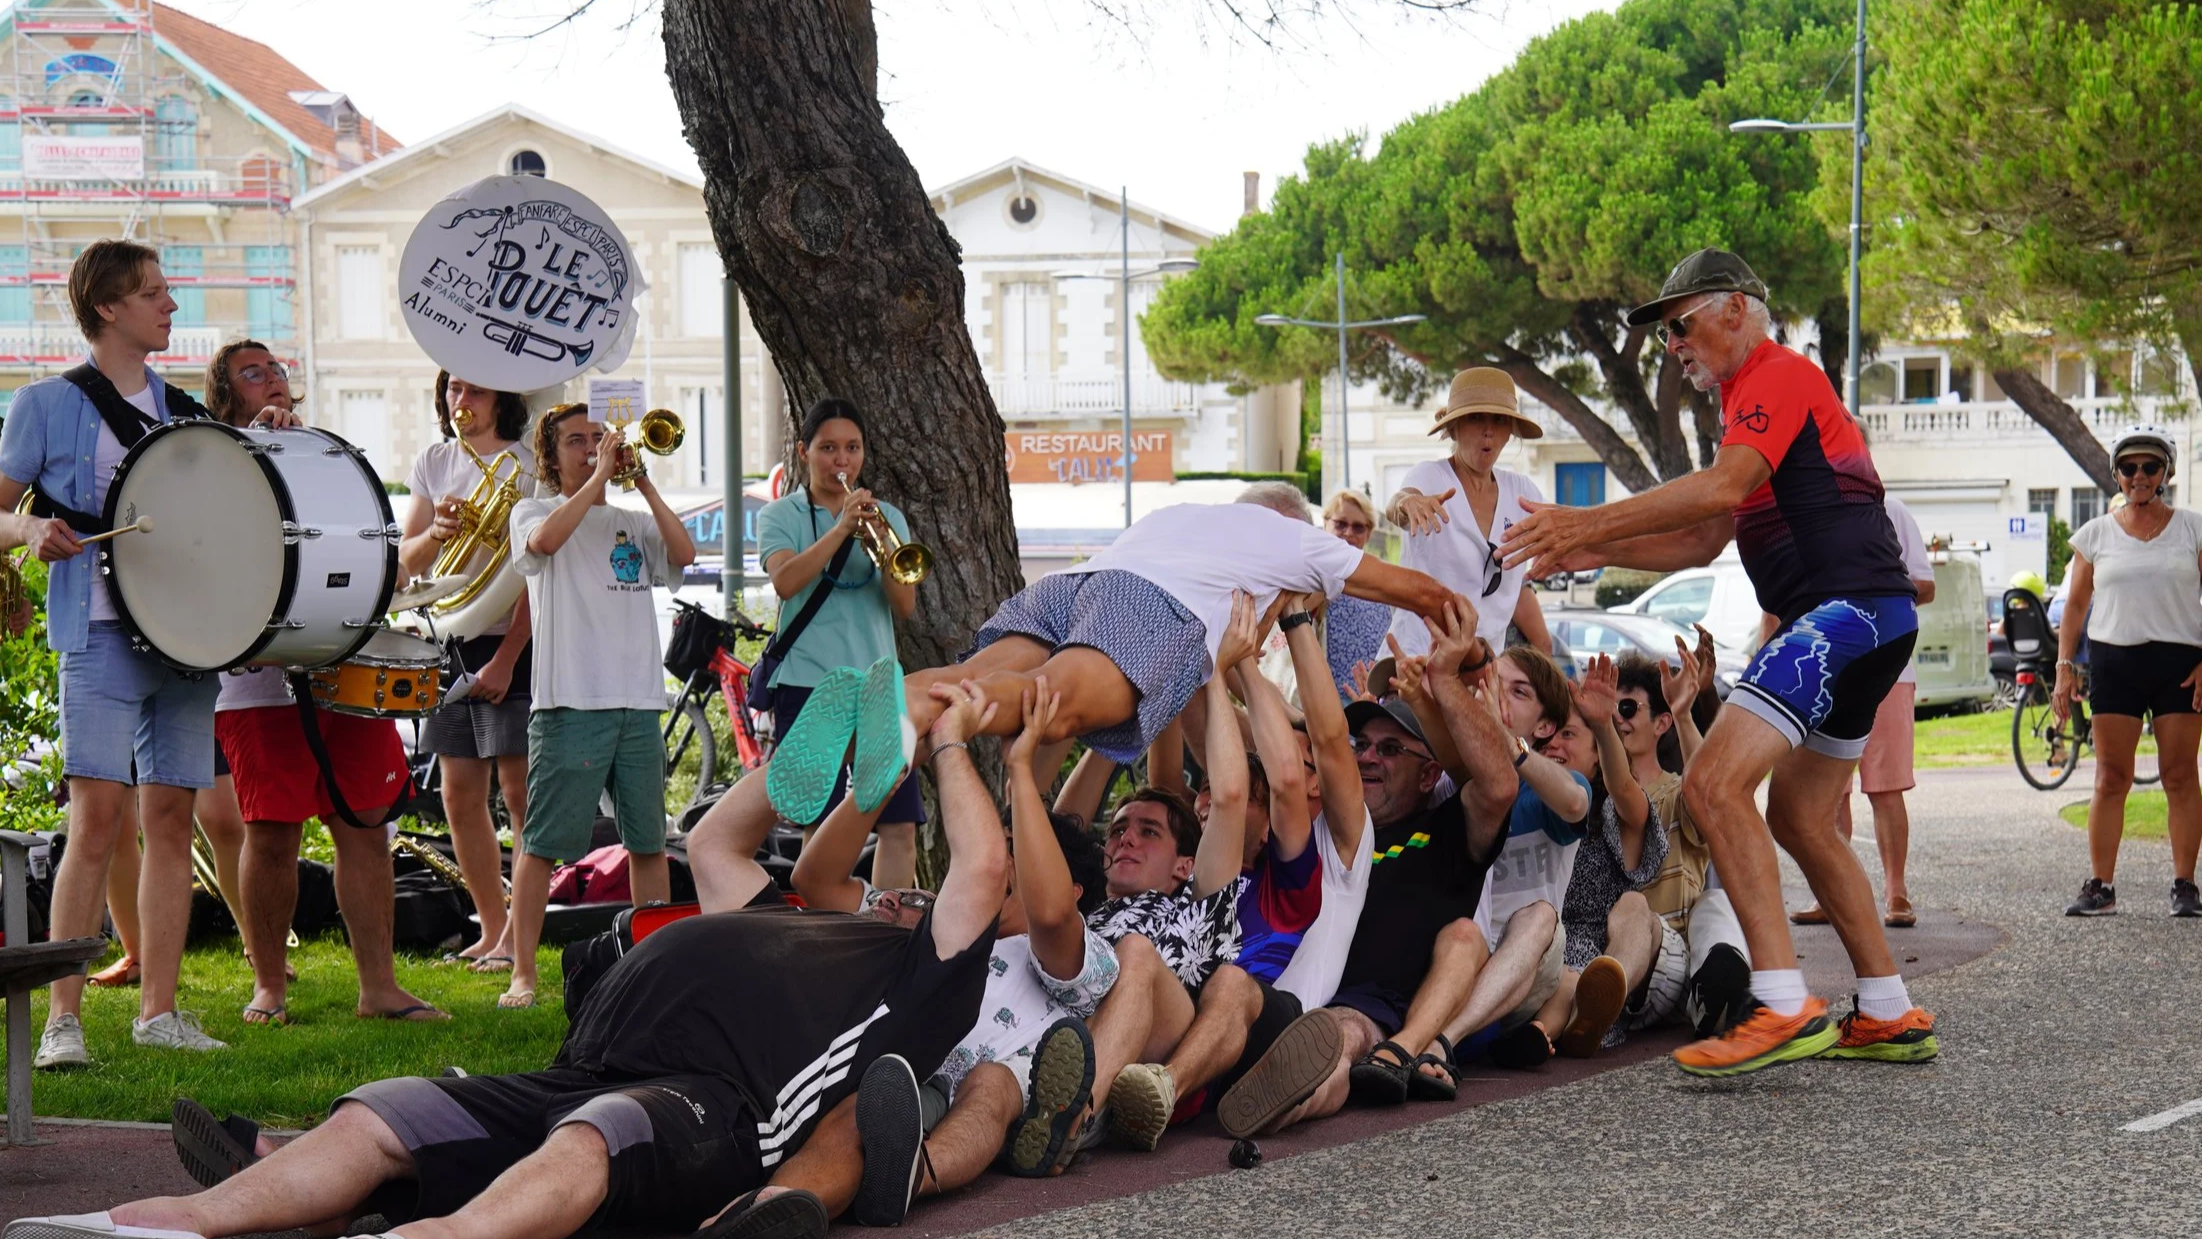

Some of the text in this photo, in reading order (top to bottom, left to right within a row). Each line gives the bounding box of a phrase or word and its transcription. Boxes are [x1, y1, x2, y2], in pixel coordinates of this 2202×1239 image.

[519, 203, 623, 267] FANFARE ESPCI PARIS
[427, 257, 491, 305] ESPCI
[542, 242, 590, 281] LE
[404, 291, 467, 335] Alumni
[433, 283, 468, 308] PARIS
[607, 584, 618, 592] THE
